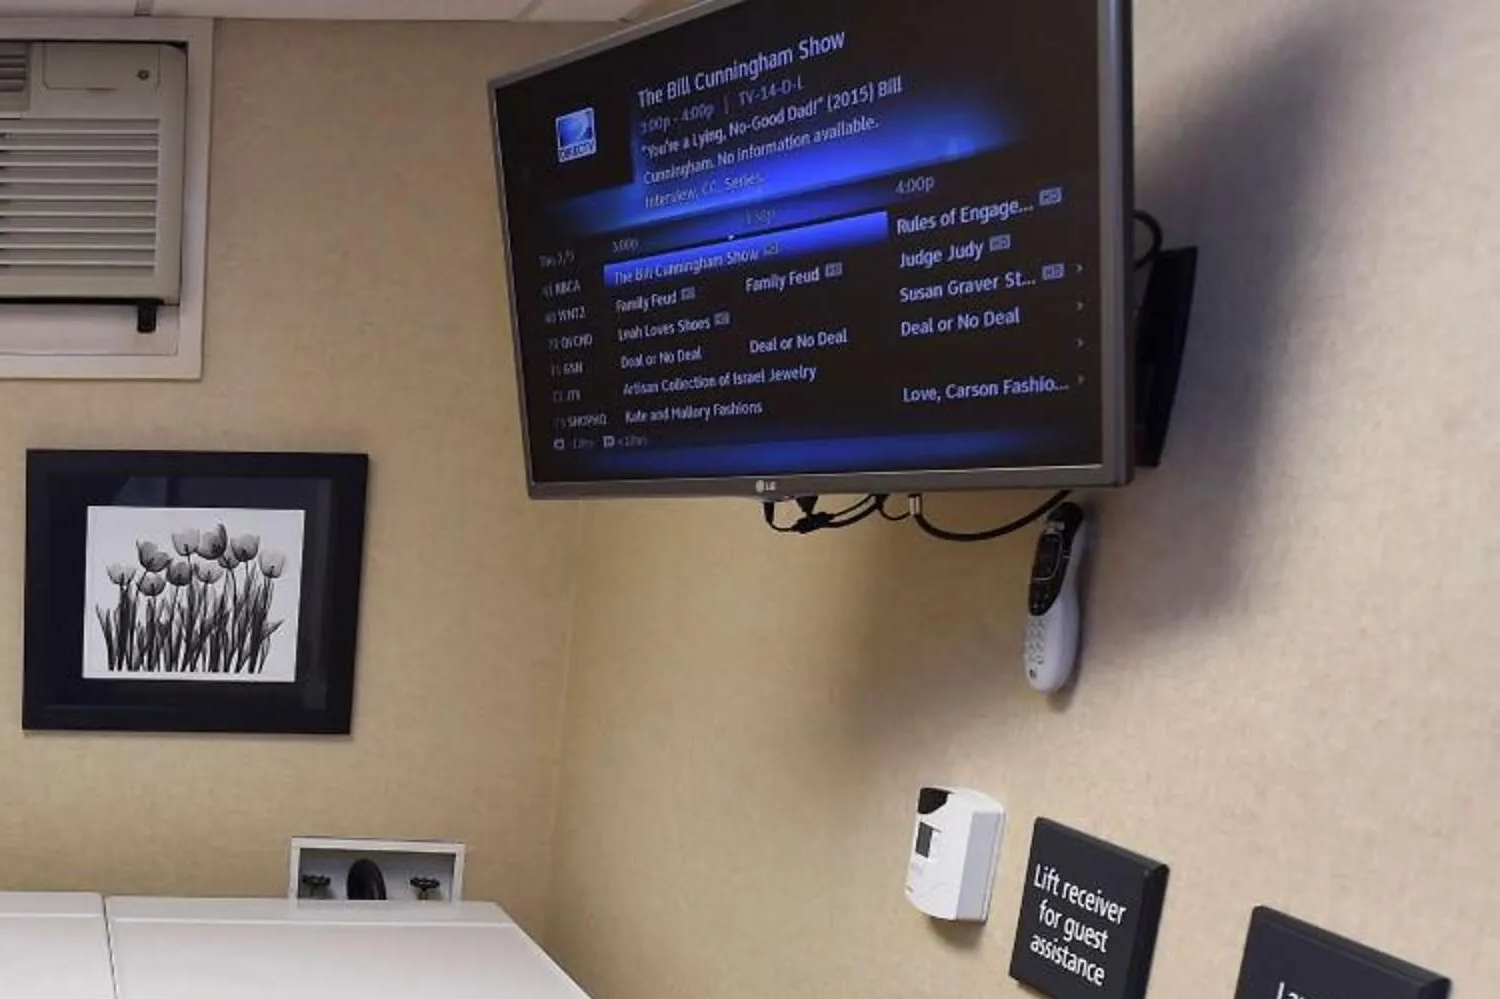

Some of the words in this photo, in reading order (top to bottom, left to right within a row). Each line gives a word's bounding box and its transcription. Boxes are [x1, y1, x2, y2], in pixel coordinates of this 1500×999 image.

[637, 88, 663, 109] The
[667, 76, 691, 99] Bill
[694, 47, 794, 91] Cunningham
[798, 31, 845, 60] Show
[729, 106, 785, 137] No-Good
[827, 82, 873, 112] (2015)
[878, 75, 903, 98] Bill
[717, 150, 735, 167] No
[737, 133, 811, 163] information
[814, 115, 880, 143] available.
[896, 176, 935, 195] 4:00p
[897, 214, 937, 235] Rules
[940, 208, 957, 227] of
[960, 200, 1034, 224] Engage...
[615, 270, 633, 285] The
[635, 266, 653, 282] Bill
[656, 254, 724, 278] Cunningham
[727, 249, 759, 266] Show
[899, 250, 943, 269] Judge
[948, 240, 984, 262] Judy
[745, 273, 787, 293] Family
[789, 266, 820, 286] Feud
[900, 284, 943, 303] Susan
[947, 276, 999, 296] Graver
[1005, 271, 1036, 289] St...
[616, 295, 649, 313] Family
[651, 289, 678, 307] Feud
[618, 324, 643, 341] Leah
[645, 320, 675, 337] Loves
[678, 316, 712, 332] Shoes
[900, 318, 934, 336] Deal
[937, 318, 954, 332] or
[957, 314, 979, 329] No
[983, 306, 1020, 327] Deal
[750, 336, 777, 353] Deal
[780, 337, 793, 350] or
[796, 333, 815, 349] No
[817, 328, 847, 346] Deal
[620, 354, 643, 369] Deal
[645, 354, 657, 366] or
[659, 350, 676, 364] No
[677, 346, 702, 363] Deal
[623, 380, 659, 396] Artisan
[661, 374, 716, 392] Collection
[719, 372, 730, 387] of
[733, 368, 766, 384] Israel
[769, 364, 817, 383] Jewelry
[903, 387, 941, 403] Love,
[945, 382, 999, 399] Carson
[1003, 375, 1069, 395] Fashio...
[625, 410, 648, 424] Kate
[650, 407, 669, 422] and
[671, 405, 711, 423] Mallory
[713, 401, 764, 418] Fashions
[1032, 863, 1060, 896] Lift
[1062, 879, 1127, 925] receiver
[1039, 899, 1062, 930] for
[1063, 917, 1109, 953] guest
[1029, 933, 1105, 987] assistance
